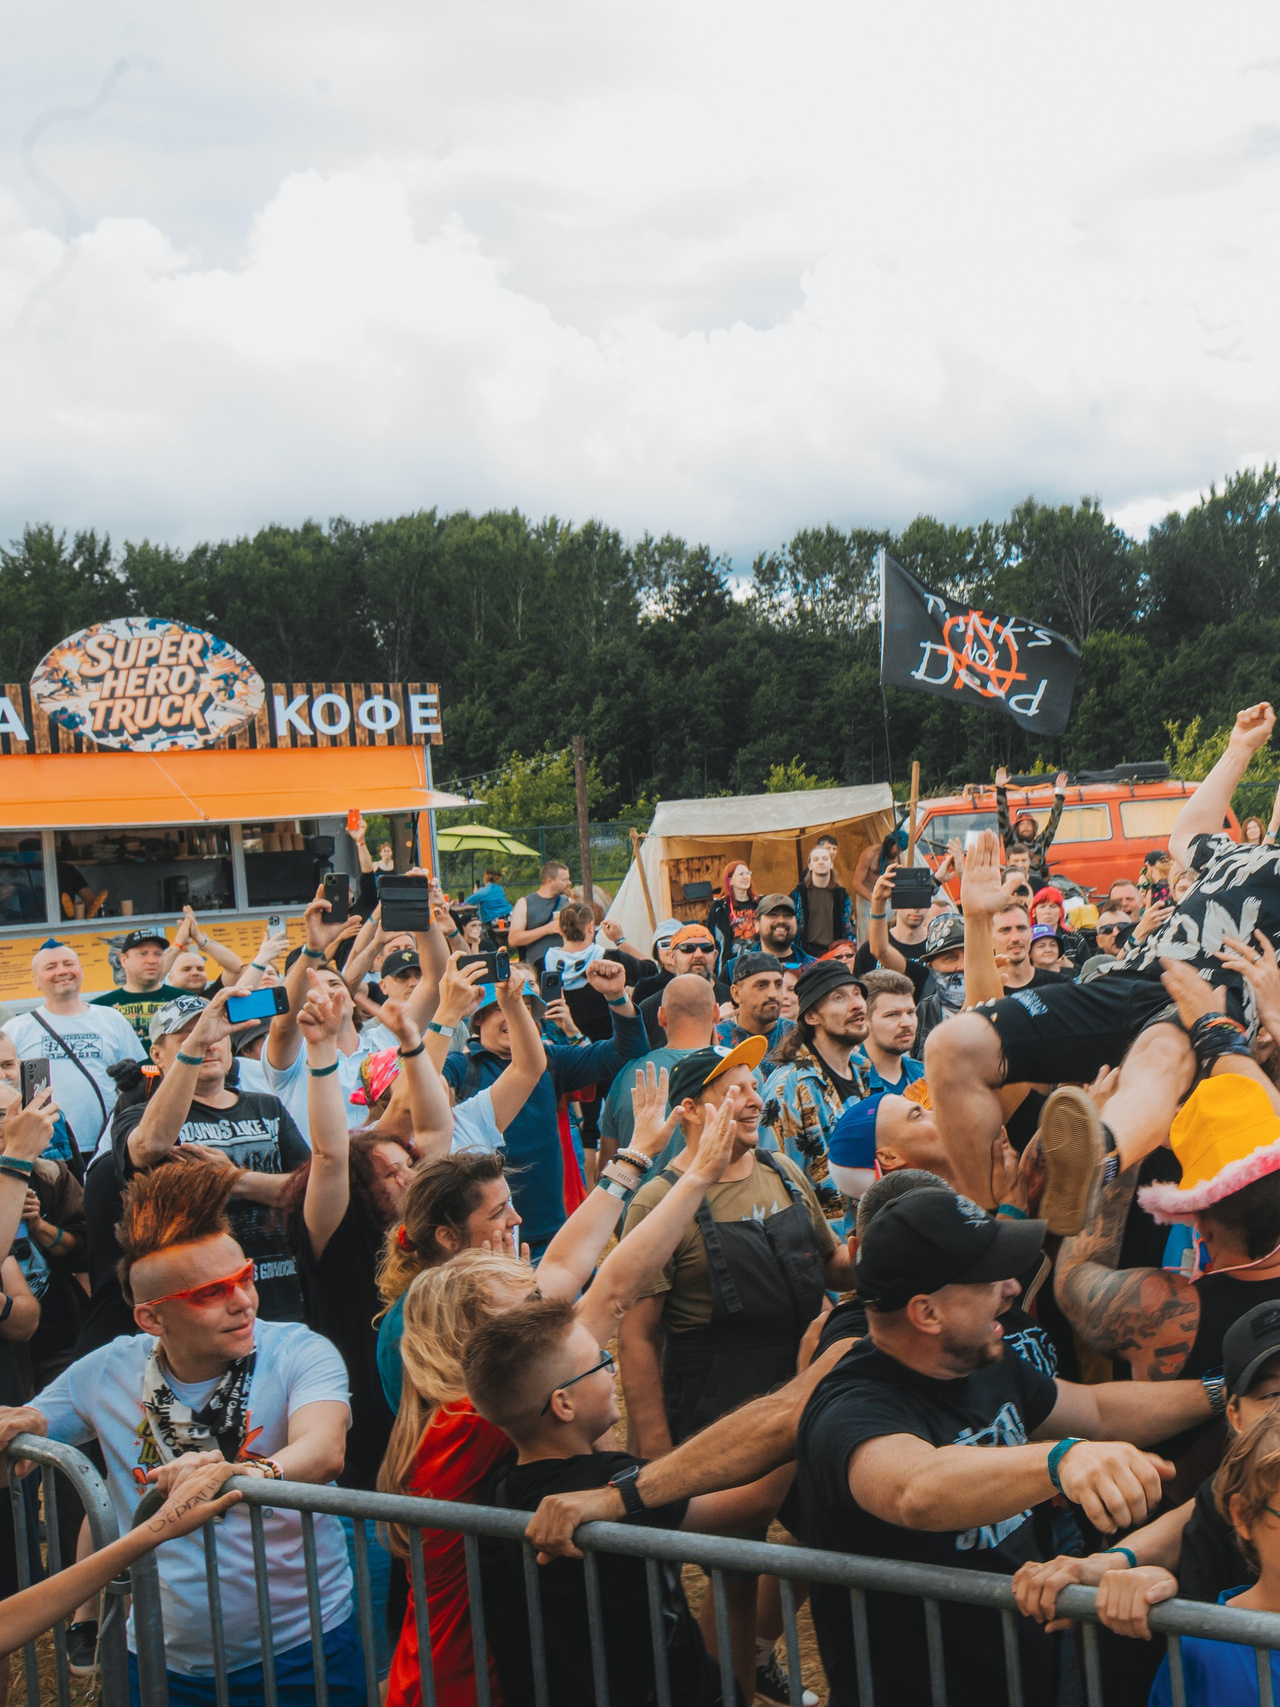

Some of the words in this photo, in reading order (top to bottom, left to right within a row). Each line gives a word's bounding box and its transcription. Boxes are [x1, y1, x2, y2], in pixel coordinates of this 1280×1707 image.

[77, 632, 206, 678] SUPER
[100, 664, 197, 700] HERO
[88, 692, 212, 736] TRUCK
[273, 693, 441, 736] КОФЕ
[231, 1119, 266, 1136] LIKE
